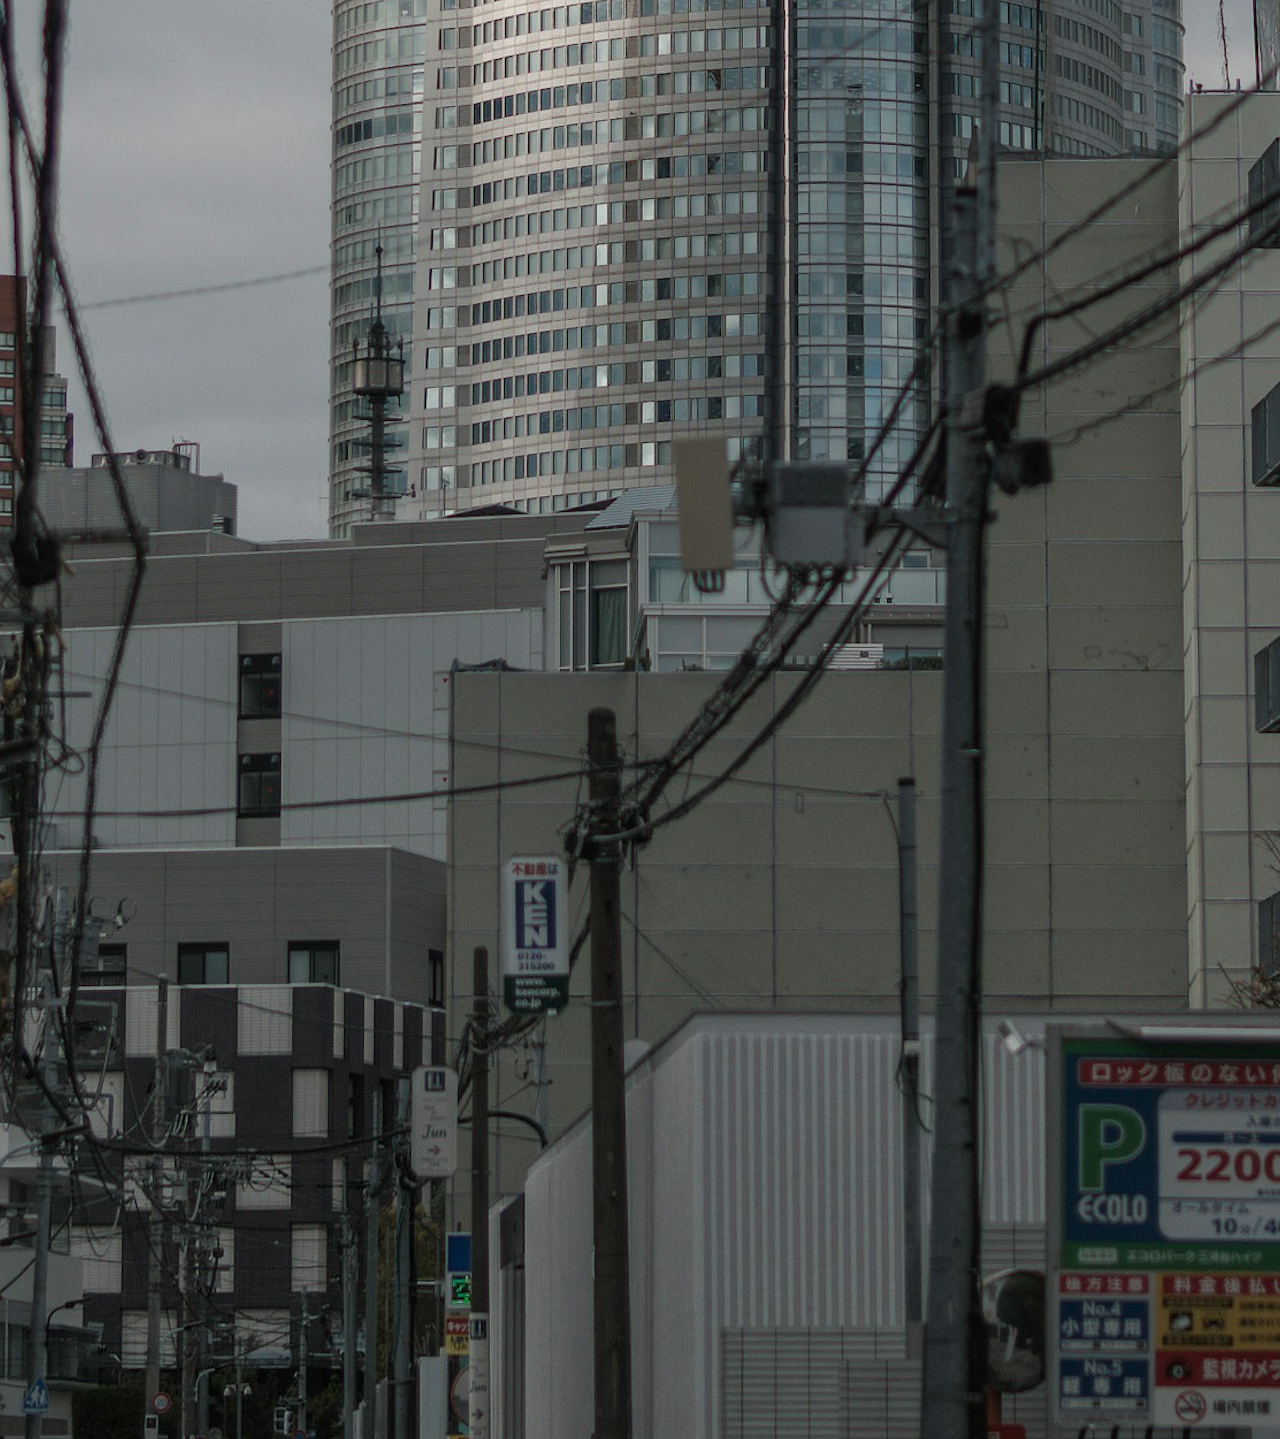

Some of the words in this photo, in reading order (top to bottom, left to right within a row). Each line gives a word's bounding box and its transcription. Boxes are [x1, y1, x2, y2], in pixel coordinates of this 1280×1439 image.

[513, 862, 558, 875] 不動産は
[523, 883, 548, 947] KEN
[515, 986, 561, 998] kencorp.
[515, 998, 542, 1008] co.jp
[422, 1124, 447, 1139] Jun
[1077, 1102, 1147, 1193] P
[1076, 1194, 1148, 1224] ECOLO
[1082, 1301, 1121, 1317] No.4
[1083, 1361, 1122, 1376] No.5
